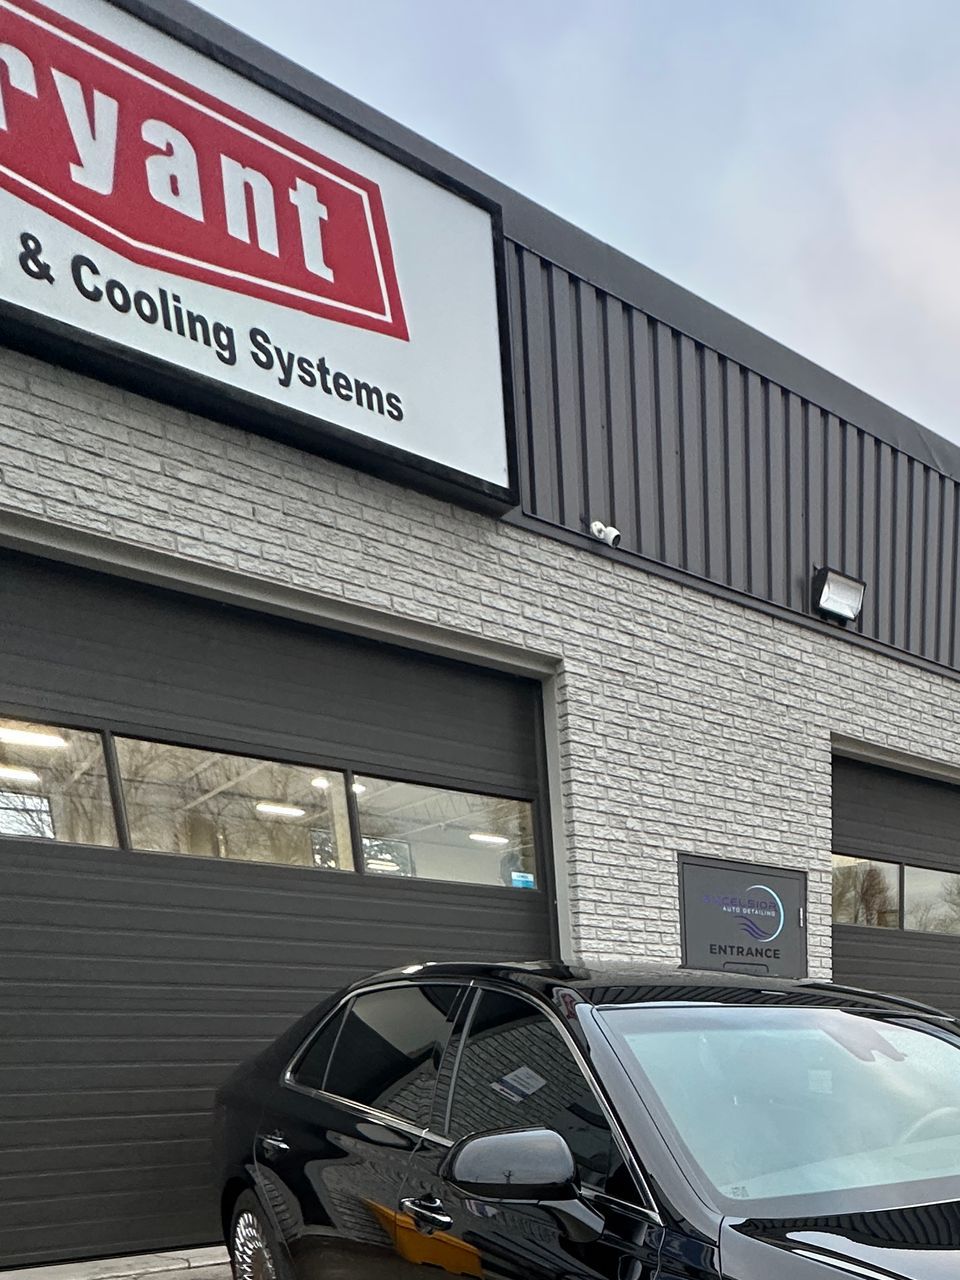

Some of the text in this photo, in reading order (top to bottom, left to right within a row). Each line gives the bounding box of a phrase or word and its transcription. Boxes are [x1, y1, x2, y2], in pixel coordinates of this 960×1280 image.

[18, 232, 404, 422] & Cooling Systems
[742, 907, 776, 917] DETAILING
[710, 944, 781, 959] ENTRANCE
